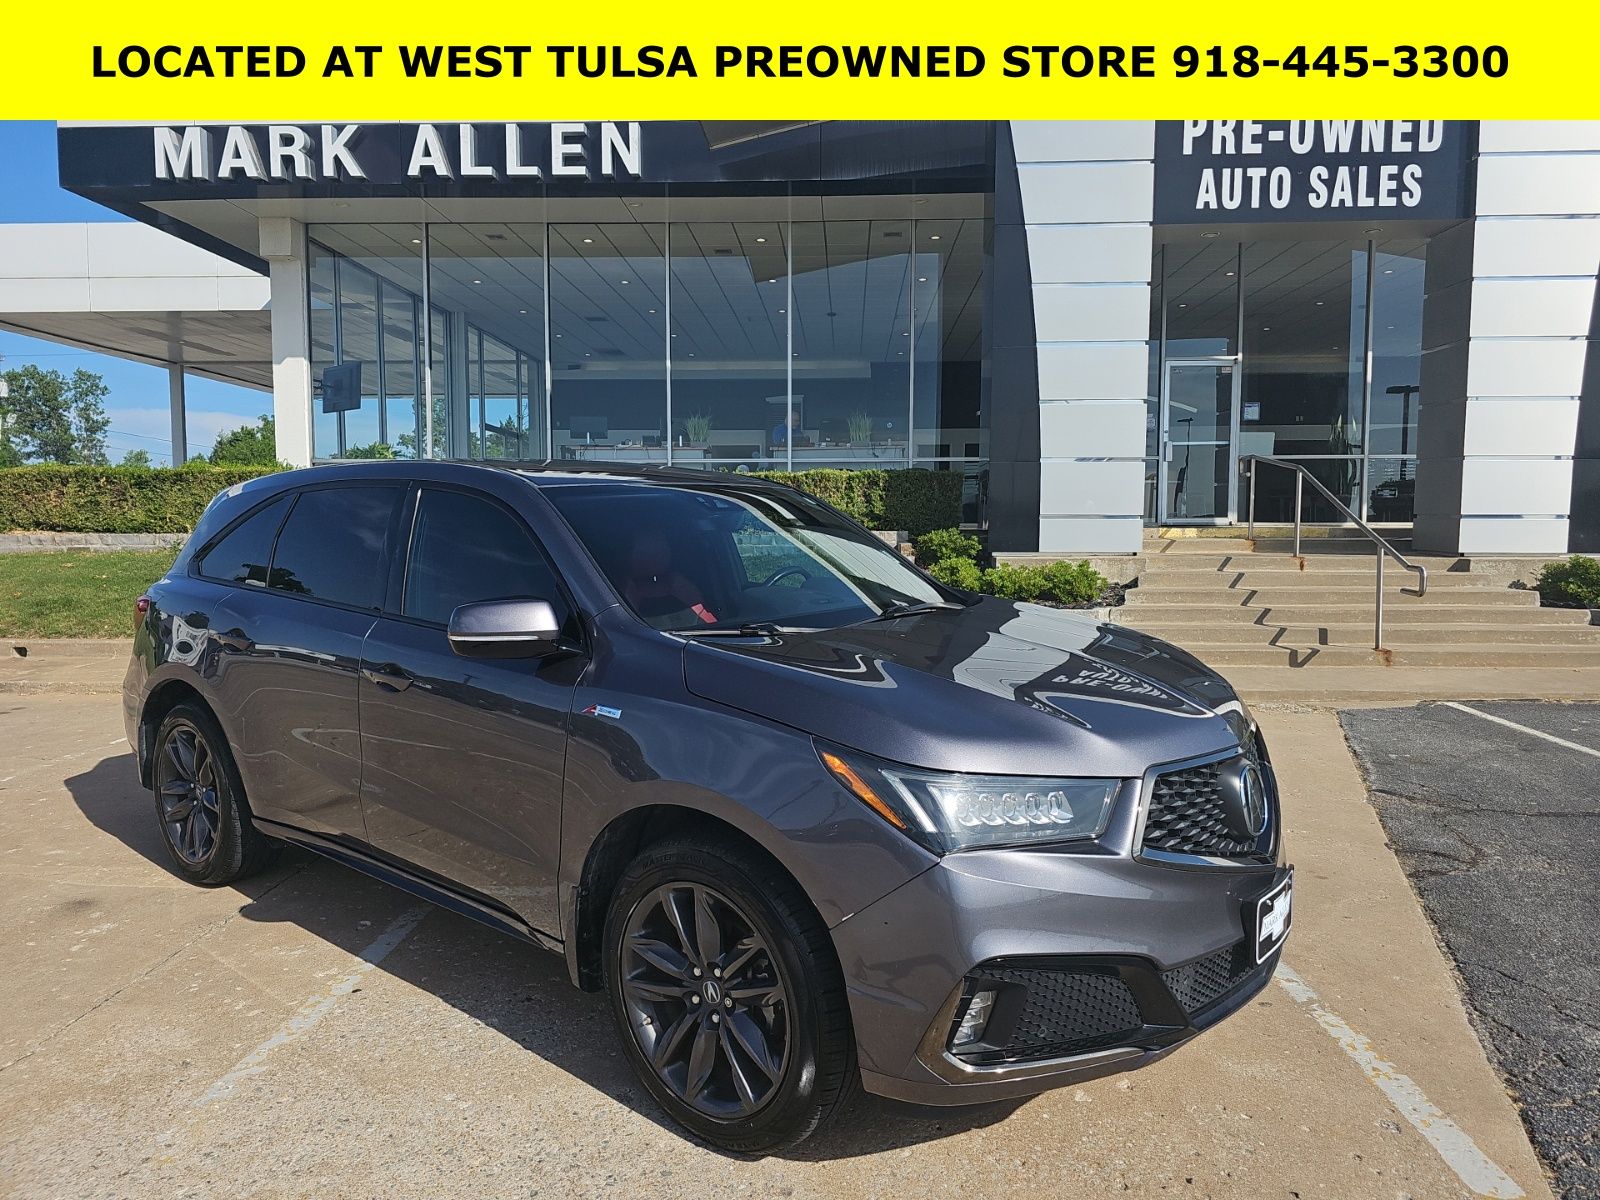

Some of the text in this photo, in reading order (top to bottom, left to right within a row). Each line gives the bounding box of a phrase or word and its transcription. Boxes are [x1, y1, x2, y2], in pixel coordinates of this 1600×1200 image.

[153, 121, 644, 182] MARK ALLEN
[1182, 120, 1445, 155] PRE-OWNED
[1195, 163, 1423, 210] AUTO SALES
